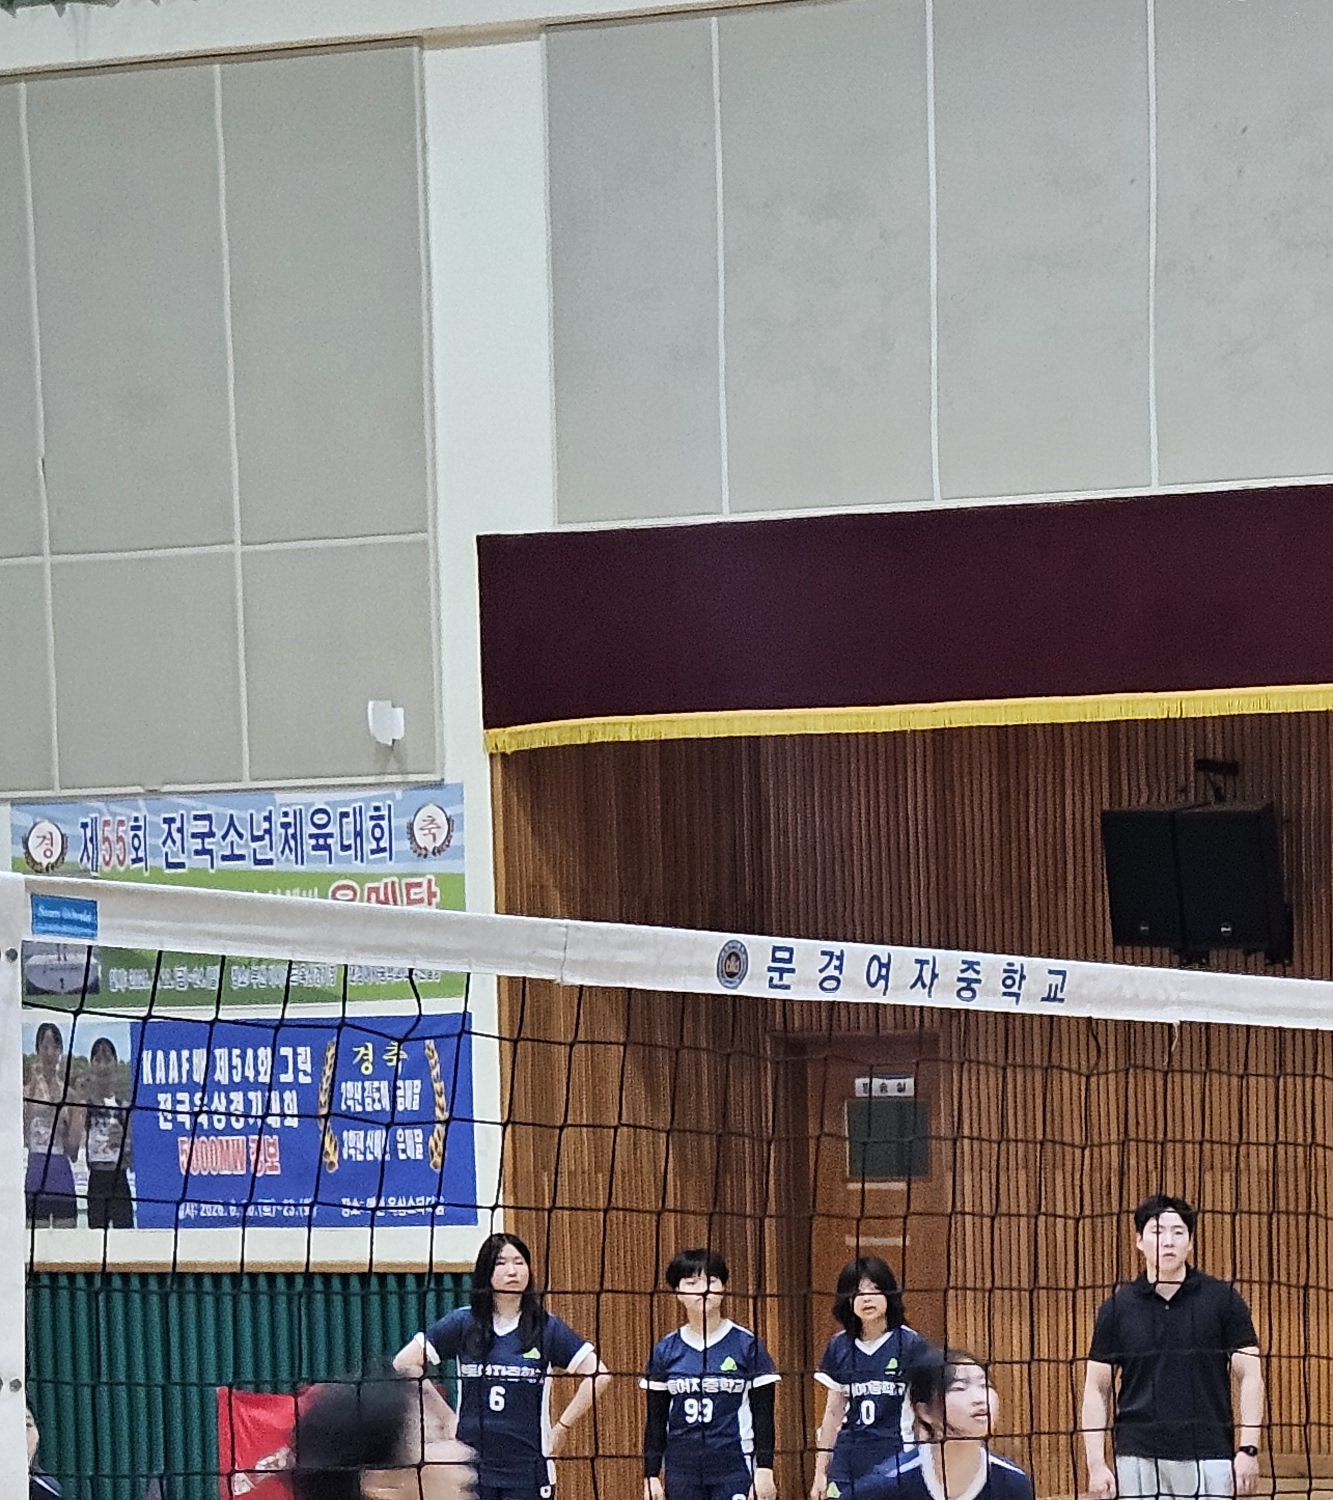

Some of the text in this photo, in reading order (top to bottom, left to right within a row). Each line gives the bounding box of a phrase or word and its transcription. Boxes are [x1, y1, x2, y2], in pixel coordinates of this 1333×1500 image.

[79, 800, 394, 873] 제55회 전국소년체육대회
[767, 944, 1069, 1006] 문경여자중학교
[488, 1385, 506, 1412] 6
[683, 1397, 714, 1424] 93
